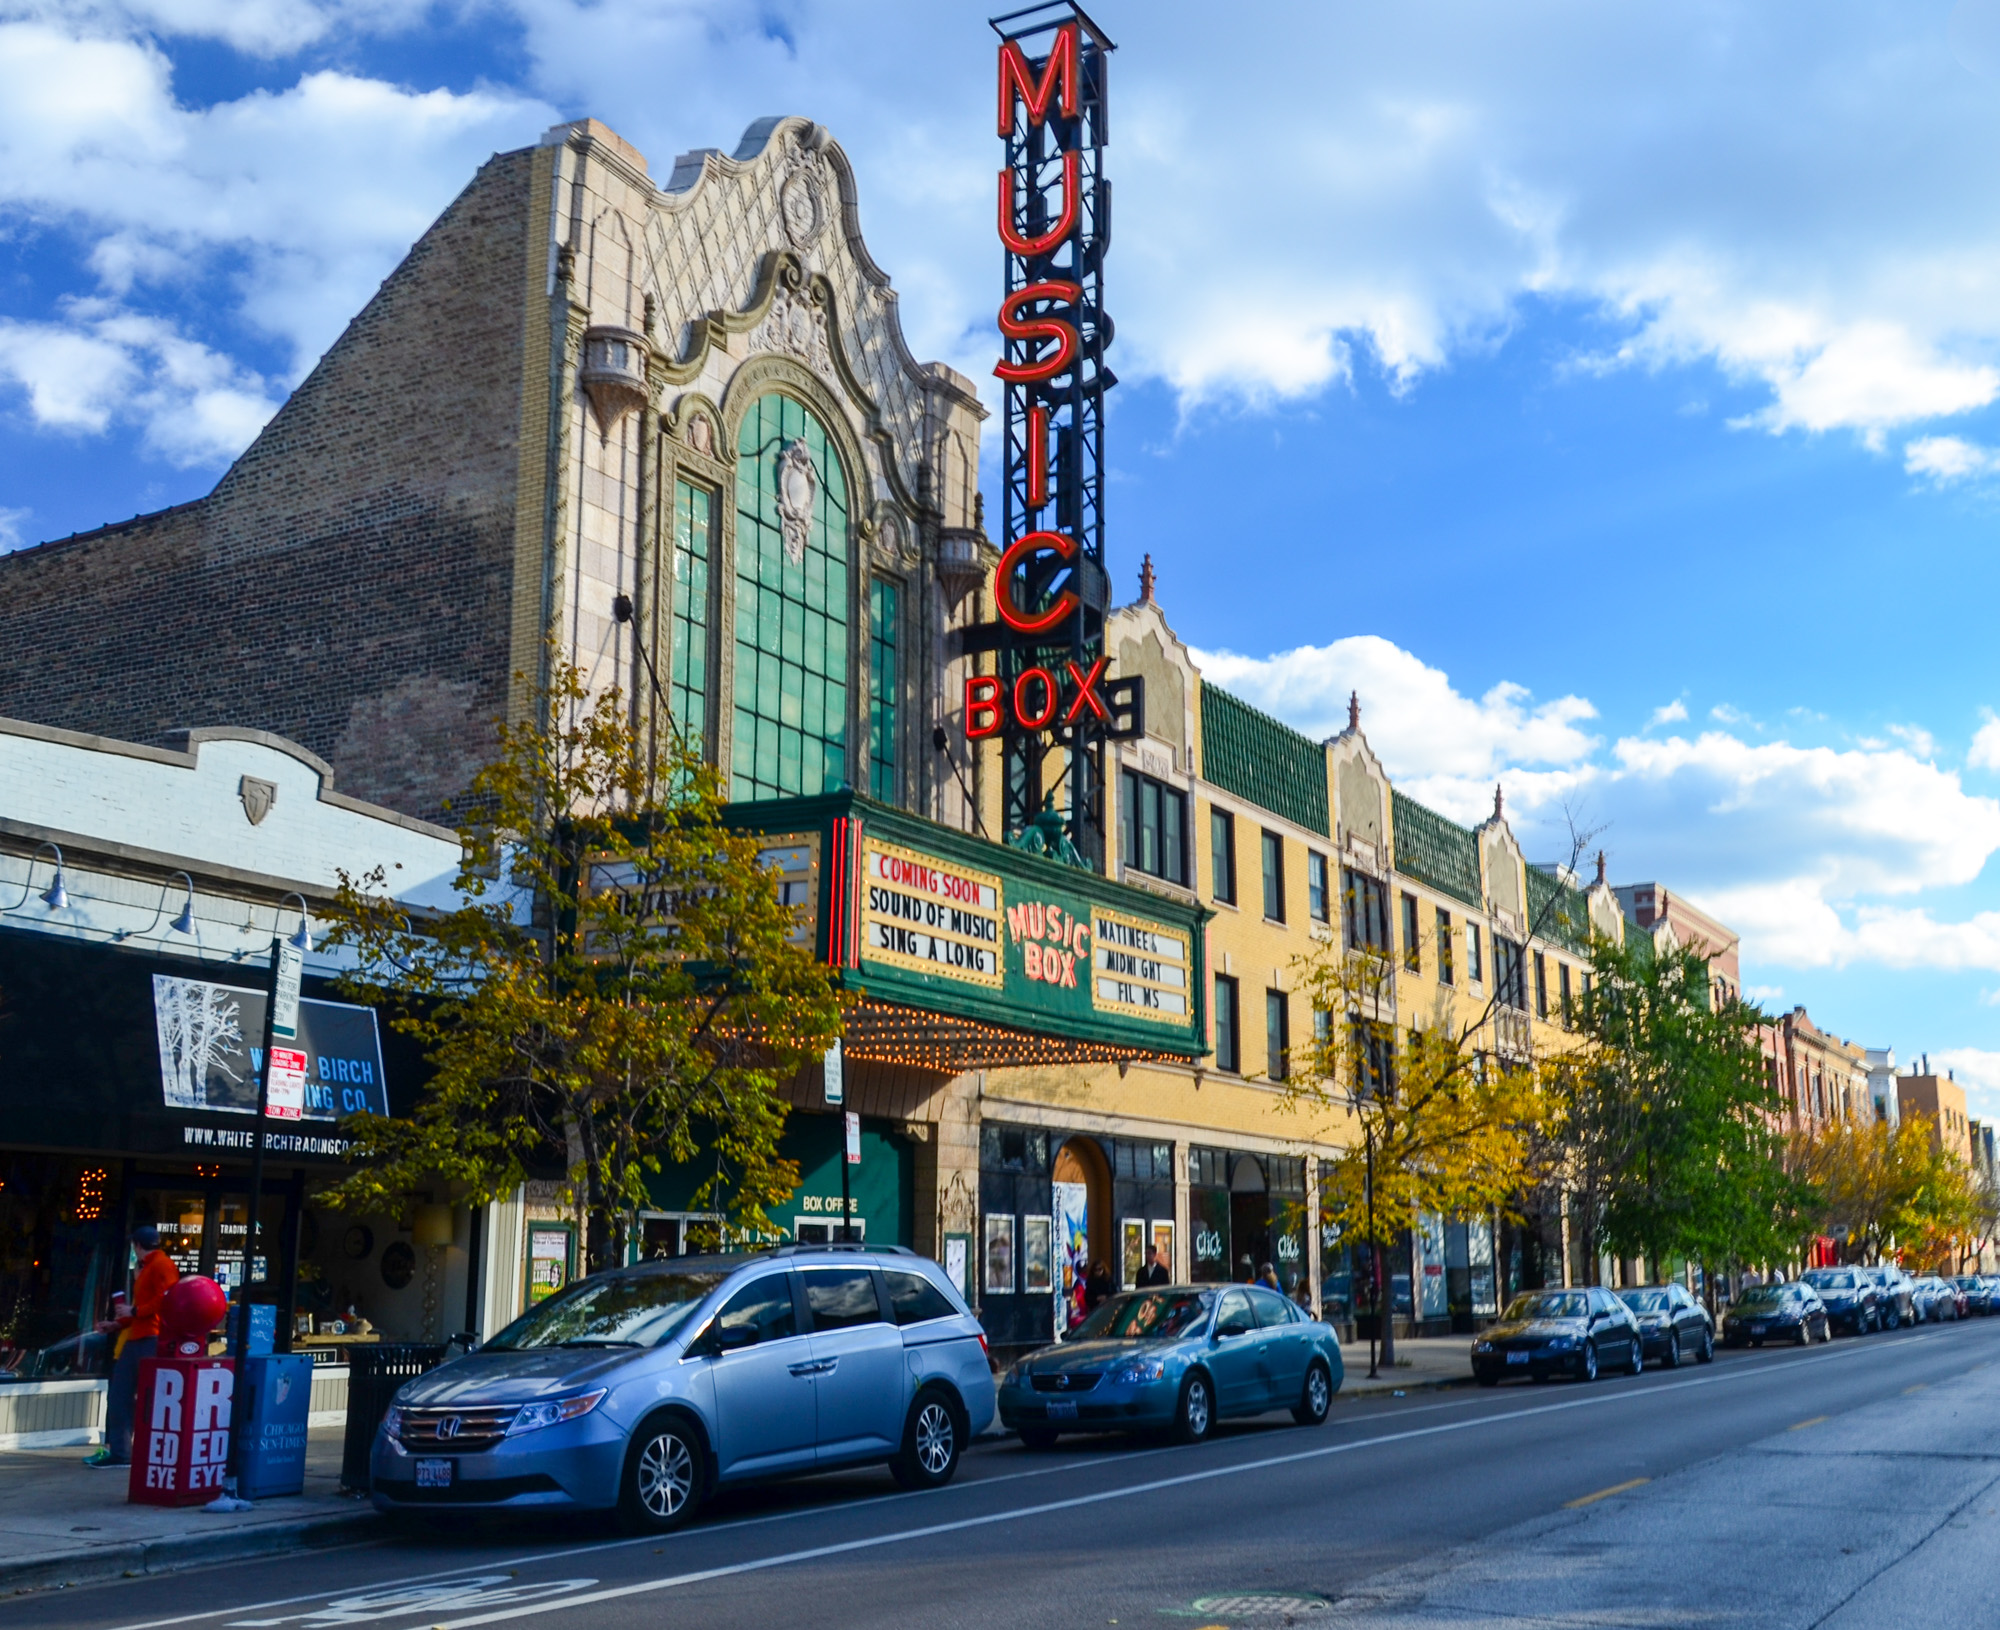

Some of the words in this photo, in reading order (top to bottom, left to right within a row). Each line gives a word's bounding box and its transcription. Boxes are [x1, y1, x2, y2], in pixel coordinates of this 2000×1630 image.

[993, 22, 1083, 633] MUSIC
[965, 656, 1114, 741] BOX
[879, 855, 938, 893] COMING
[942, 874, 980, 905] SOON
[869, 886, 922, 922] SOUND
[926, 902, 945, 929] OF
[951, 908, 995, 943] MUSIC
[1007, 901, 1091, 959] MUSIC
[880, 924, 917, 955] SING
[927, 936, 938, 961] A
[945, 940, 984, 971] LONG
[1099, 918, 1149, 951] MATINEE
[1025, 941, 1077, 989] BOX
[318, 1056, 373, 1085] BIRCH
[283, 1107, 300, 1118] ZONE
[342, 1087, 374, 1114] CO.
[803, 1195, 823, 1212] BOX
[157, 1222, 178, 1234] WHITE
[180, 1222, 202, 1235] BIRCH
[220, 1224, 248, 1236] TRADING
[151, 1368, 184, 1432] R
[193, 1367, 235, 1430] R
[190, 1429, 230, 1466] ED
[259, 1435, 306, 1452] SUN-TIMES
[264, 1422, 305, 1437] CHICAGO
[148, 1430, 180, 1466] ED
[146, 1464, 177, 1490] EYE
